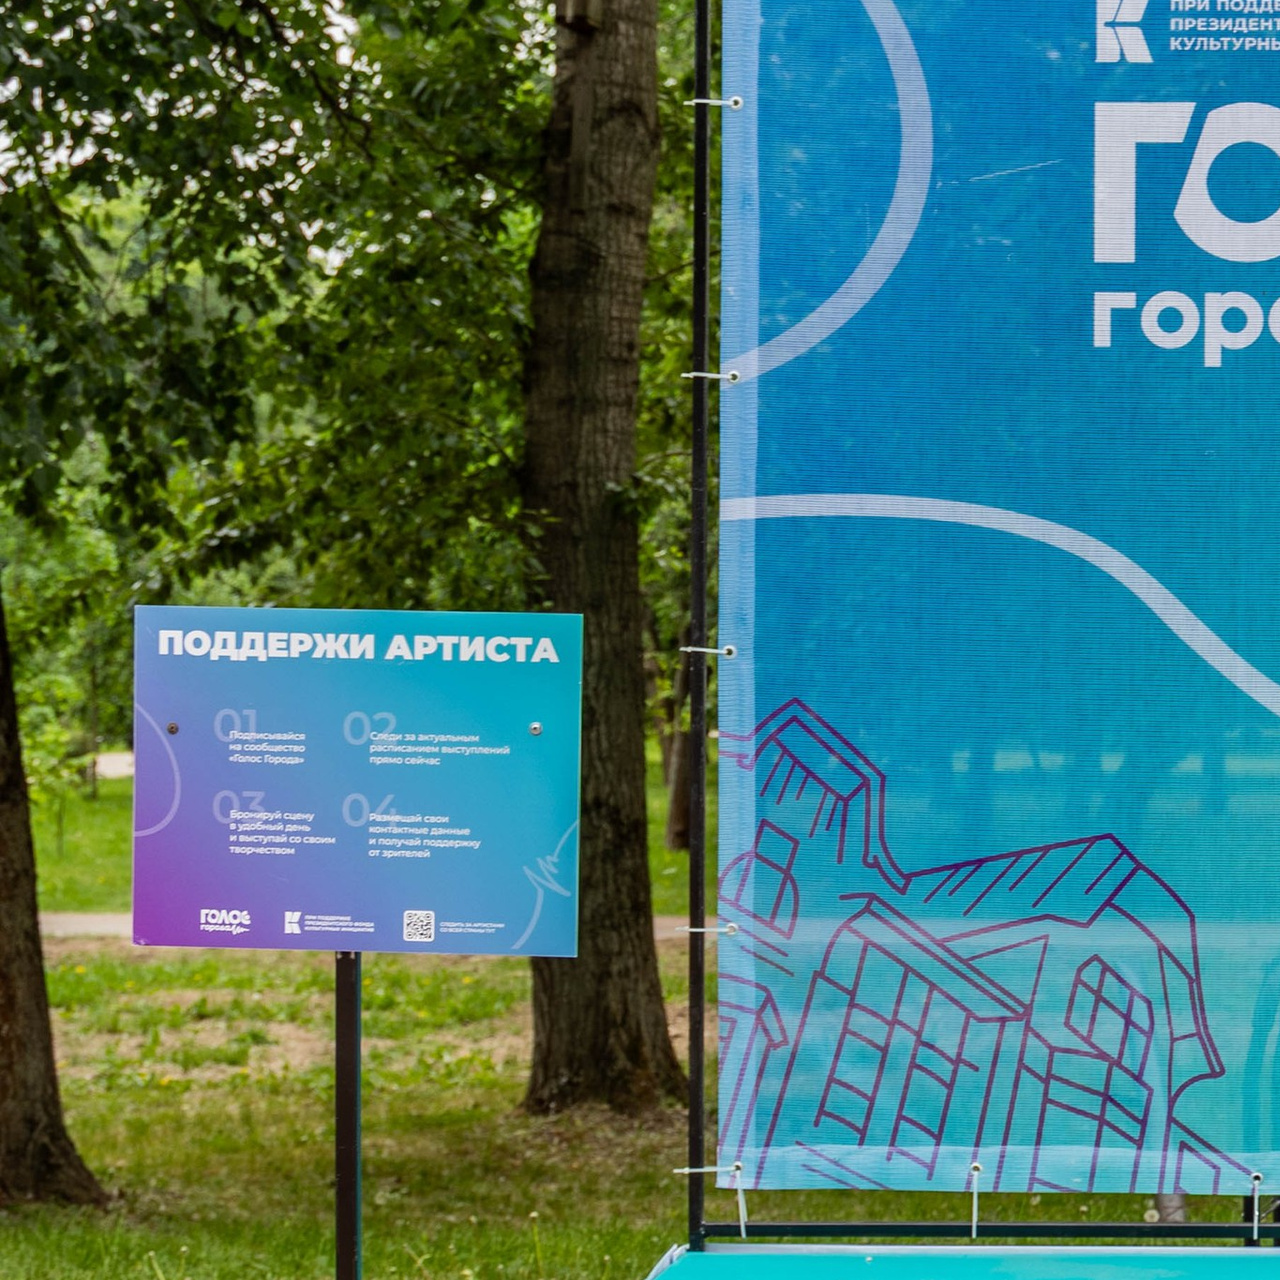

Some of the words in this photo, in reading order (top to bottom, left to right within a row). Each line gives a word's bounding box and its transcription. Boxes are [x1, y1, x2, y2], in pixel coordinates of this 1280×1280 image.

[158, 629, 375, 662] ПОДДЕРЖИ
[385, 635, 560, 663] АРТИСТА
[214, 708, 256, 742] 01
[343, 711, 397, 746] 02
[229, 730, 306, 741] Подписывайся
[369, 731, 401, 742] Следи
[403, 733, 416, 741] за
[417, 733, 480, 743] актуальным
[229, 743, 242, 751] на
[243, 743, 306, 752] сообщество
[369, 744, 440, 754] расписанием
[441, 746, 511, 756] выступлений
[369, 756, 403, 765] прямо
[404, 756, 441, 765] сейчас
[229, 809, 282, 821] Бронируй
[283, 813, 315, 822] сцену
[368, 813, 422, 823] Размещай
[423, 815, 450, 823] свои
[237, 822, 284, 832] удобный
[285, 824, 311, 832] день
[368, 826, 429, 834] контактные
[430, 827, 471, 835] данные
[239, 834, 287, 844] выступай
[378, 837, 422, 847] получай
[423, 839, 481, 849] поддержку
[229, 846, 296, 855] творчеством
[382, 849, 431, 858] зрителей
[200, 909, 251, 925] ГОЛОС
